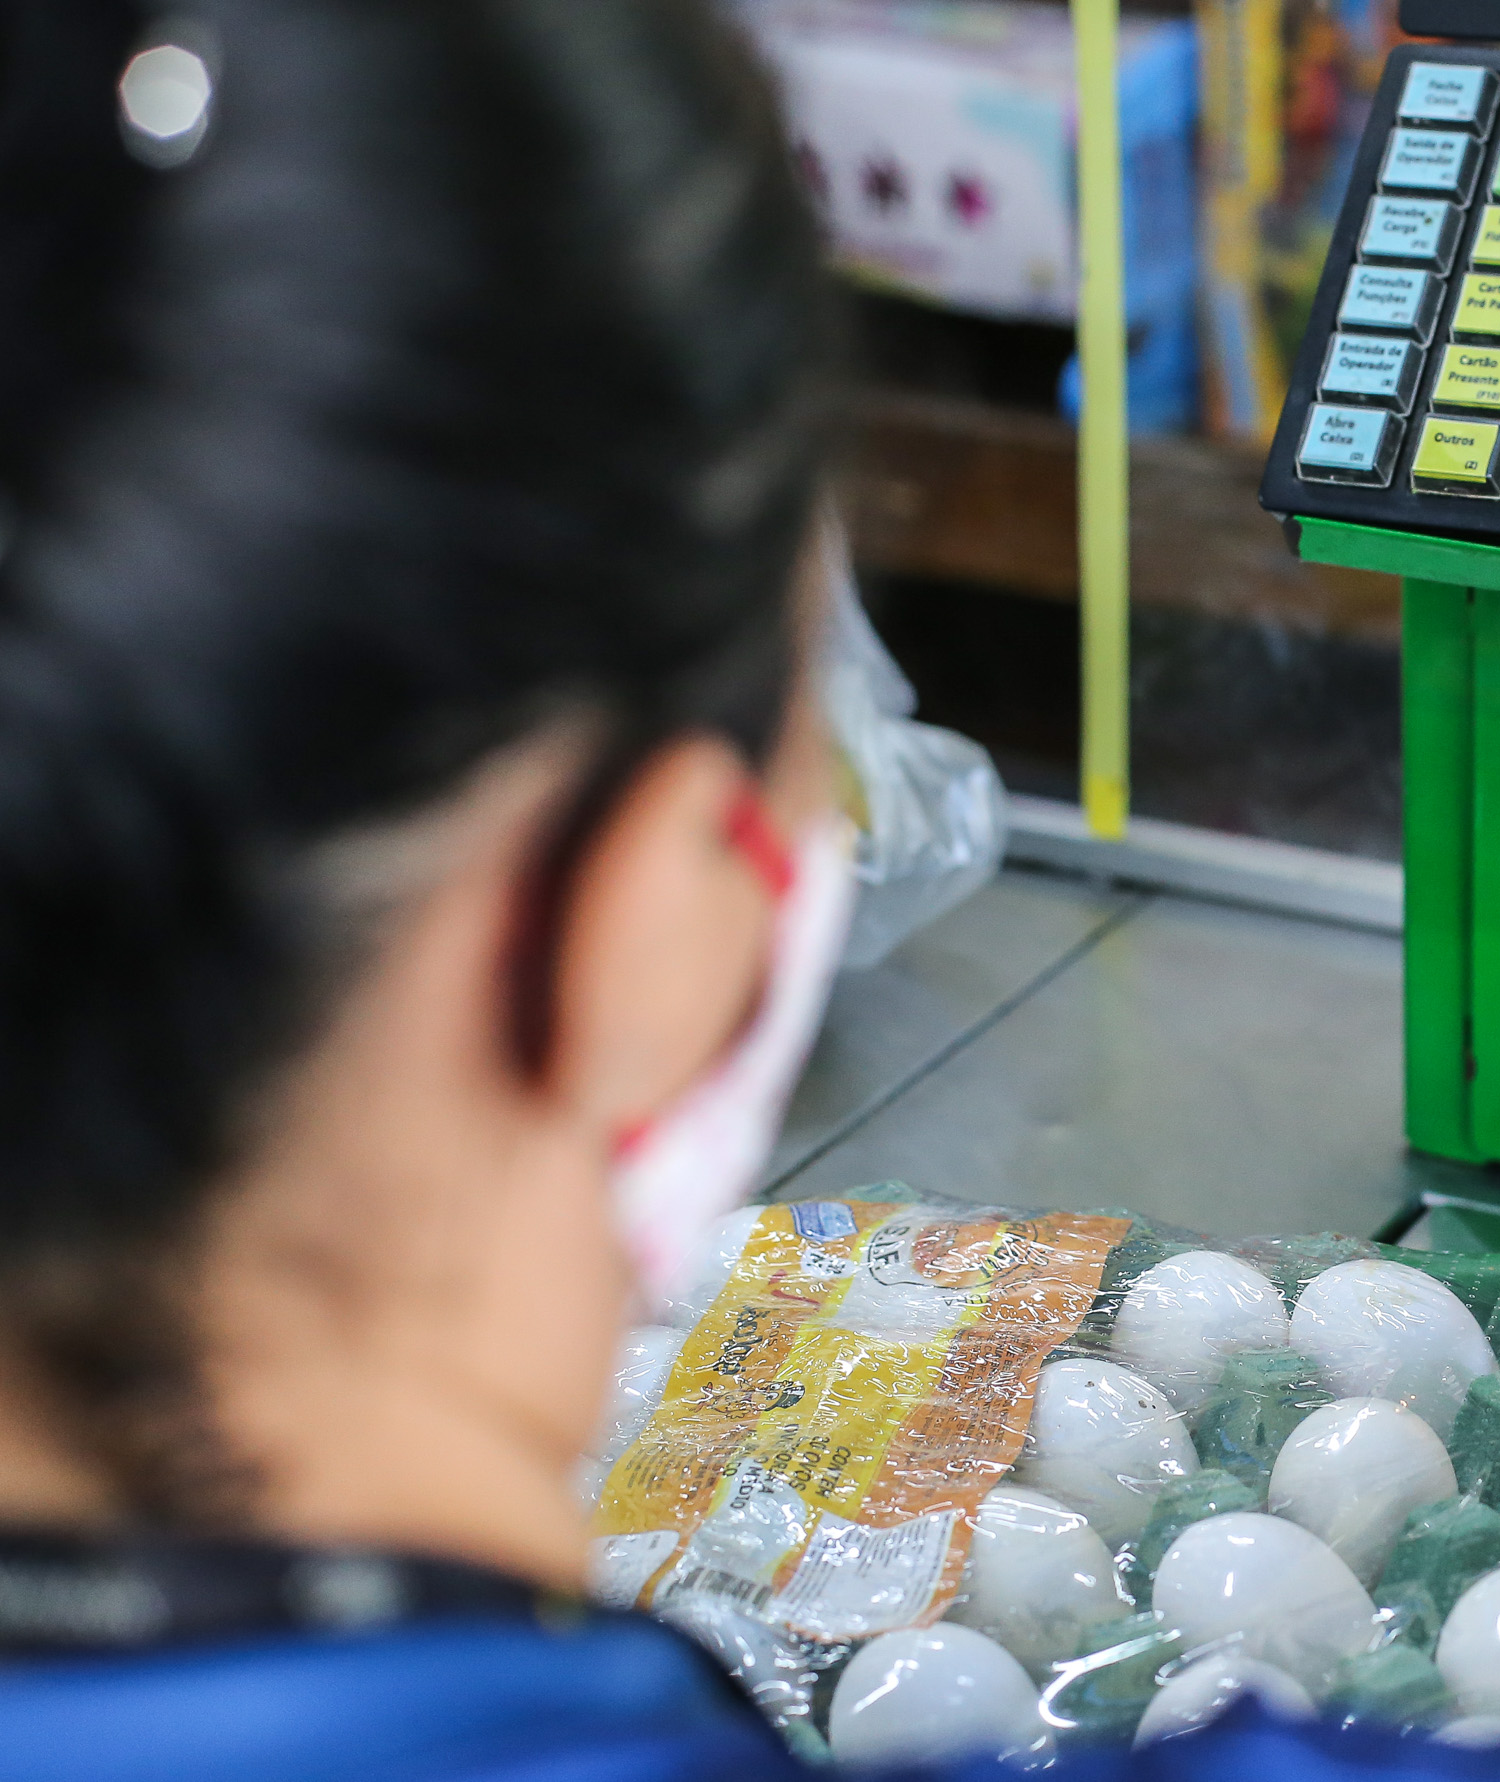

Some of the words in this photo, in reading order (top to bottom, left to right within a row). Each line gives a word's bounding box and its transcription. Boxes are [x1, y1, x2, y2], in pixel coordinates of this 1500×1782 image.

[1359, 272, 1413, 289] Consulta
[1467, 296, 1487, 310] Pré
[1339, 341, 1385, 356] Entrada
[1388, 345, 1403, 357] de
[1339, 356, 1396, 372] Operador
[1459, 354, 1499, 369] Cartão
[1447, 370, 1500, 387] Presente
[1324, 415, 1356, 430] Abre
[1319, 431, 1354, 446] Caixa
[1434, 431, 1475, 447] Outros
[1464, 460, 1479, 471] (Z)
